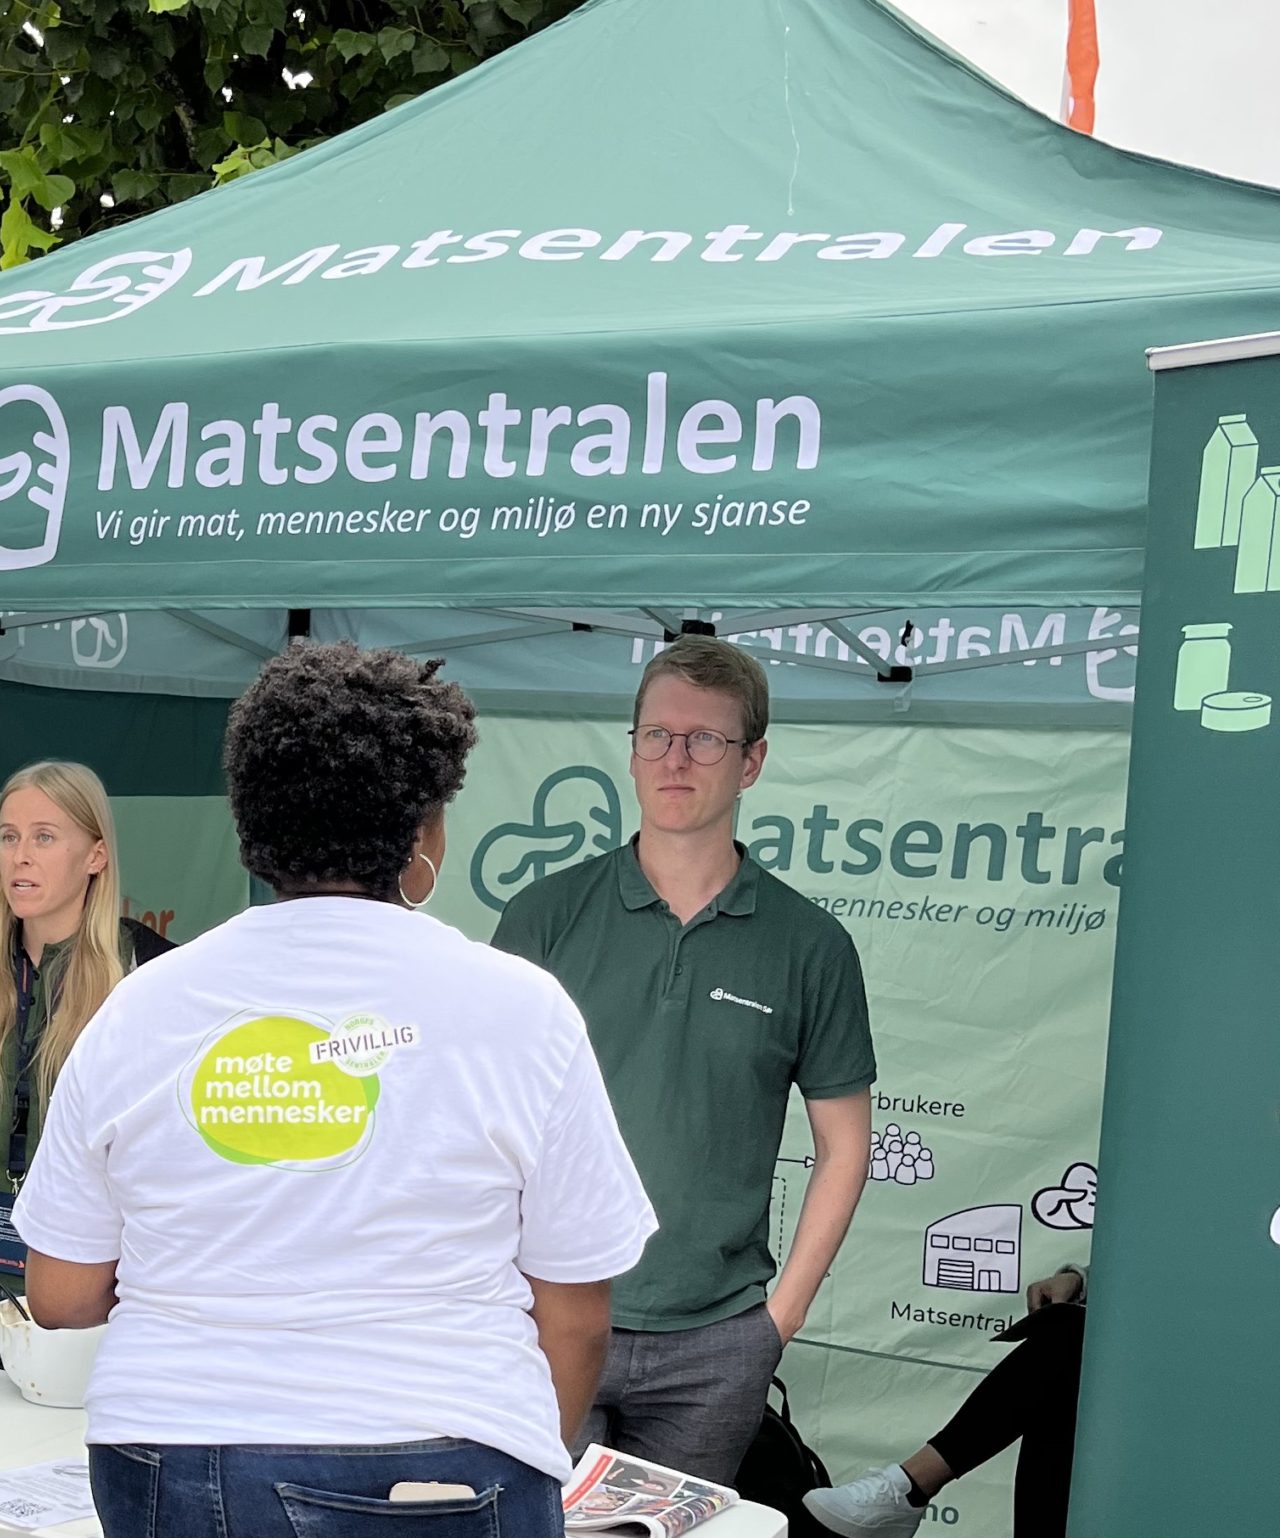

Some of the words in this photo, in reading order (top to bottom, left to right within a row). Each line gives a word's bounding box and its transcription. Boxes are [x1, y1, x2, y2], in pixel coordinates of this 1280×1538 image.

[192, 223, 1163, 297] Matsentralen
[97, 371, 821, 491] Matsentralen
[95, 509, 123, 539] Vi
[129, 508, 171, 545] gir
[177, 508, 245, 541] mat,
[256, 500, 431, 535] mennesker
[438, 506, 481, 539] og
[490, 496, 577, 537] miljø
[586, 502, 628, 529] en
[640, 502, 683, 536] ny
[691, 494, 811, 535] sjanse
[746, 804, 1126, 887] atsentr
[976, 905, 1016, 932] og
[1024, 902, 1106, 935] miljø
[315, 1026, 414, 1061] FRIVILLIG
[215, 1052, 294, 1076] møte
[205, 1075, 322, 1099] mellom
[200, 1099, 367, 1125] mennesker
[871, 1091, 965, 1118] brukere
[890, 1301, 1014, 1333] Matsentral
